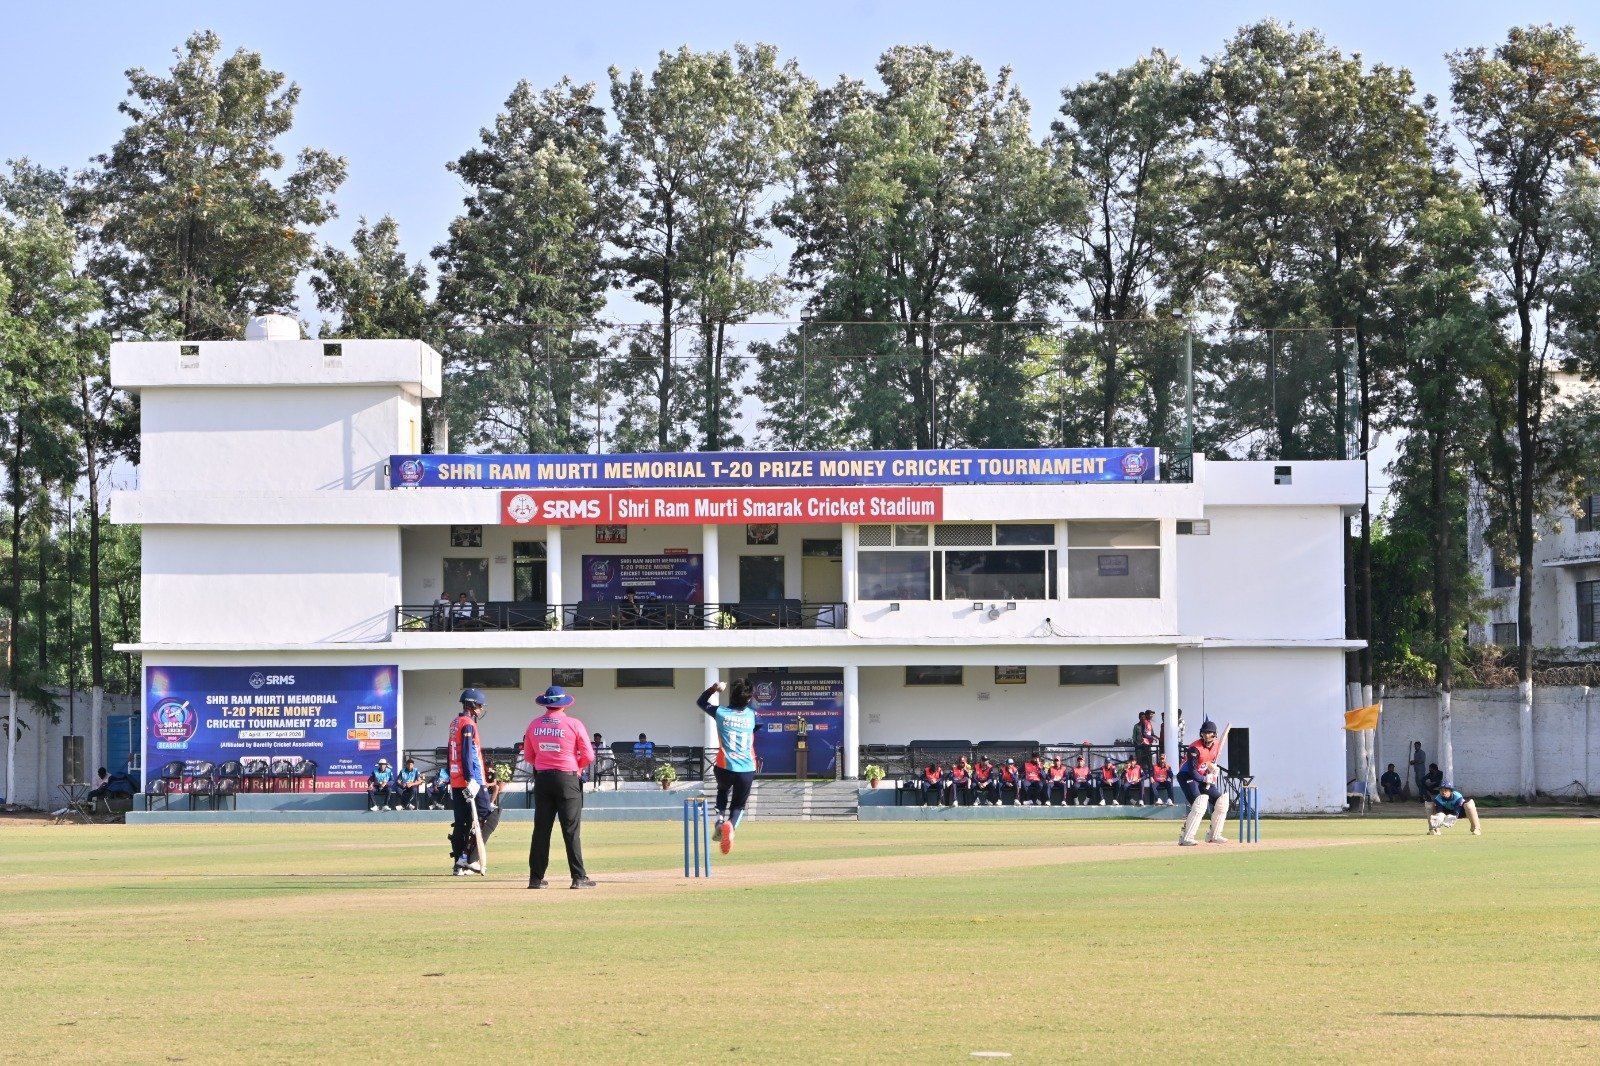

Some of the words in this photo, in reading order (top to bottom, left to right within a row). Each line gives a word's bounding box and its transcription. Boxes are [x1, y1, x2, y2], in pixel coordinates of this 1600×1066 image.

[438, 463, 482, 480] SHRI
[489, 463, 530, 480] RAM
[537, 462, 598, 480] MURTI
[604, 461, 706, 479] MEMORIAL
[711, 461, 752, 478] T-20
[756, 460, 813, 478] PRIZE
[820, 460, 887, 477] MONEY
[892, 459, 973, 476] CRICKET
[978, 457, 1107, 475] TOURNAMENT
[543, 500, 601, 519] SRMS
[618, 498, 650, 518] Shri
[655, 498, 690, 518] Ram
[695, 498, 738, 517] Murti
[743, 498, 803, 517] Smarak
[808, 497, 866, 517] Cricket
[870, 497, 935, 516] Stadium
[266, 675, 295, 685] SRMS
[206, 695, 228, 705] SHRI
[231, 695, 252, 705] RAM
[254, 694, 285, 704] MURTI
[287, 694, 338, 704] MEMORIAL
[222, 706, 246, 717] T-20
[249, 706, 280, 716] PRIZE
[284, 705, 321, 716] MONEY
[206, 719, 245, 729] CRICKET
[248, 718, 311, 729] TOURNAMENT
[313, 718, 337, 728] 2026
[368, 713, 381, 722] LIC
[533, 726, 566, 738] UMPIRE
[728, 730, 748, 752] 11
[308, 779, 346, 789] Smarak
[349, 779, 369, 789] Trus
